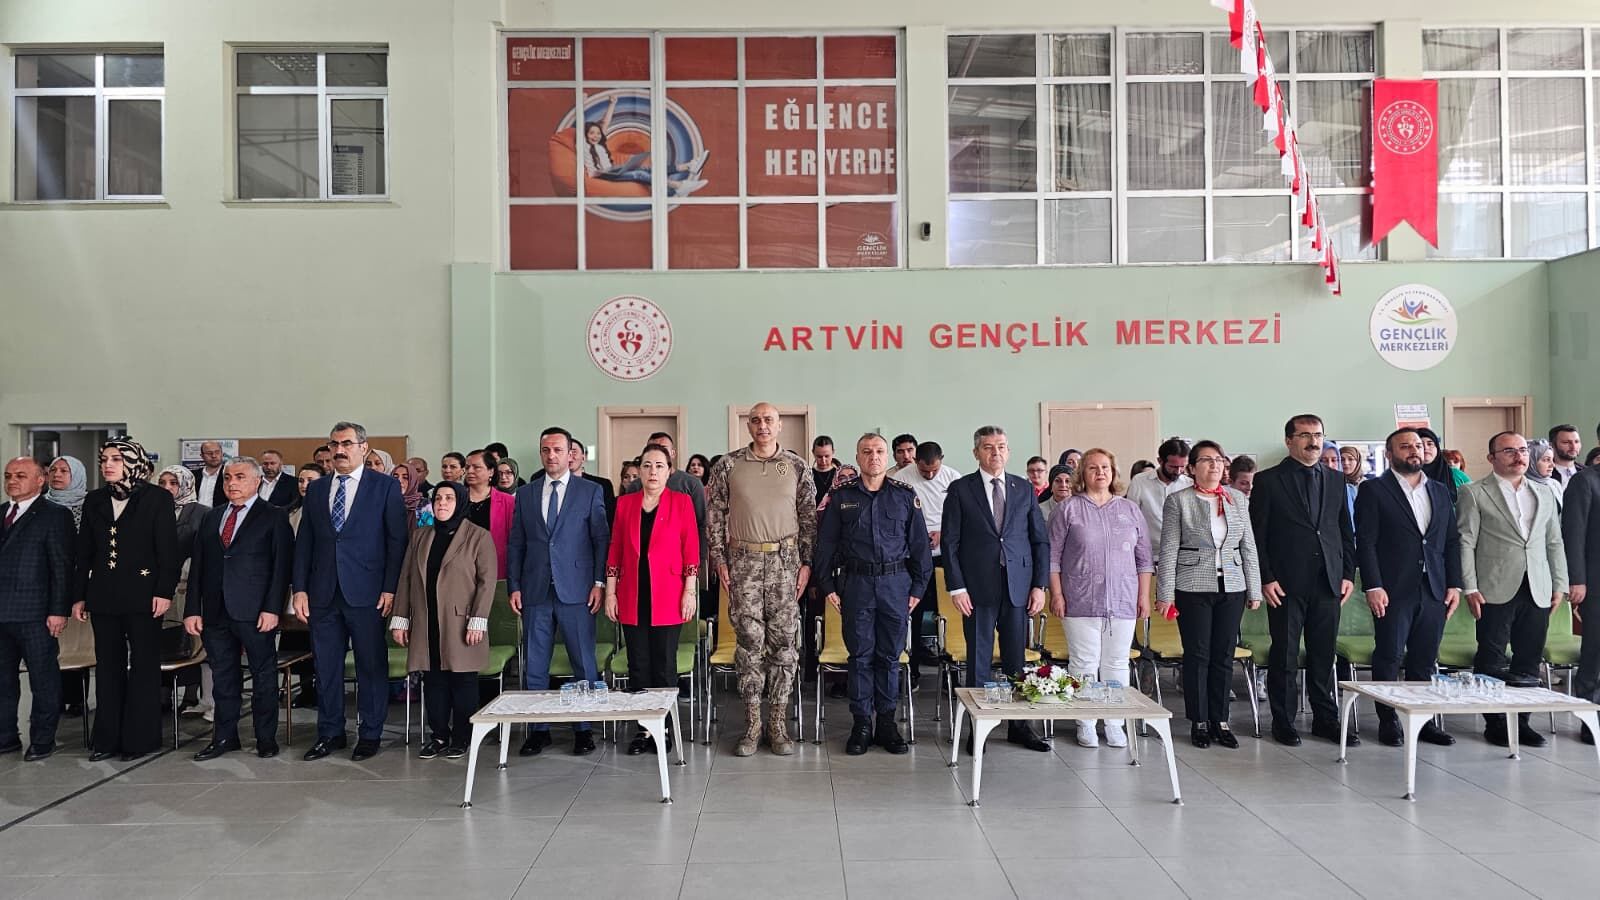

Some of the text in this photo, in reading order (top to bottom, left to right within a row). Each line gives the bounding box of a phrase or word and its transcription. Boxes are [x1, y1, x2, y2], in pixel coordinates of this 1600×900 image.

[765, 98, 888, 130] EĞLENCE
[765, 148, 895, 176] HER YERDE
[764, 312, 1281, 354] ARTVİN GENÇLİK MERKEZİ
[1380, 327, 1447, 341] GENÇLİK
[1380, 341, 1449, 352] MERKEZLERİ
